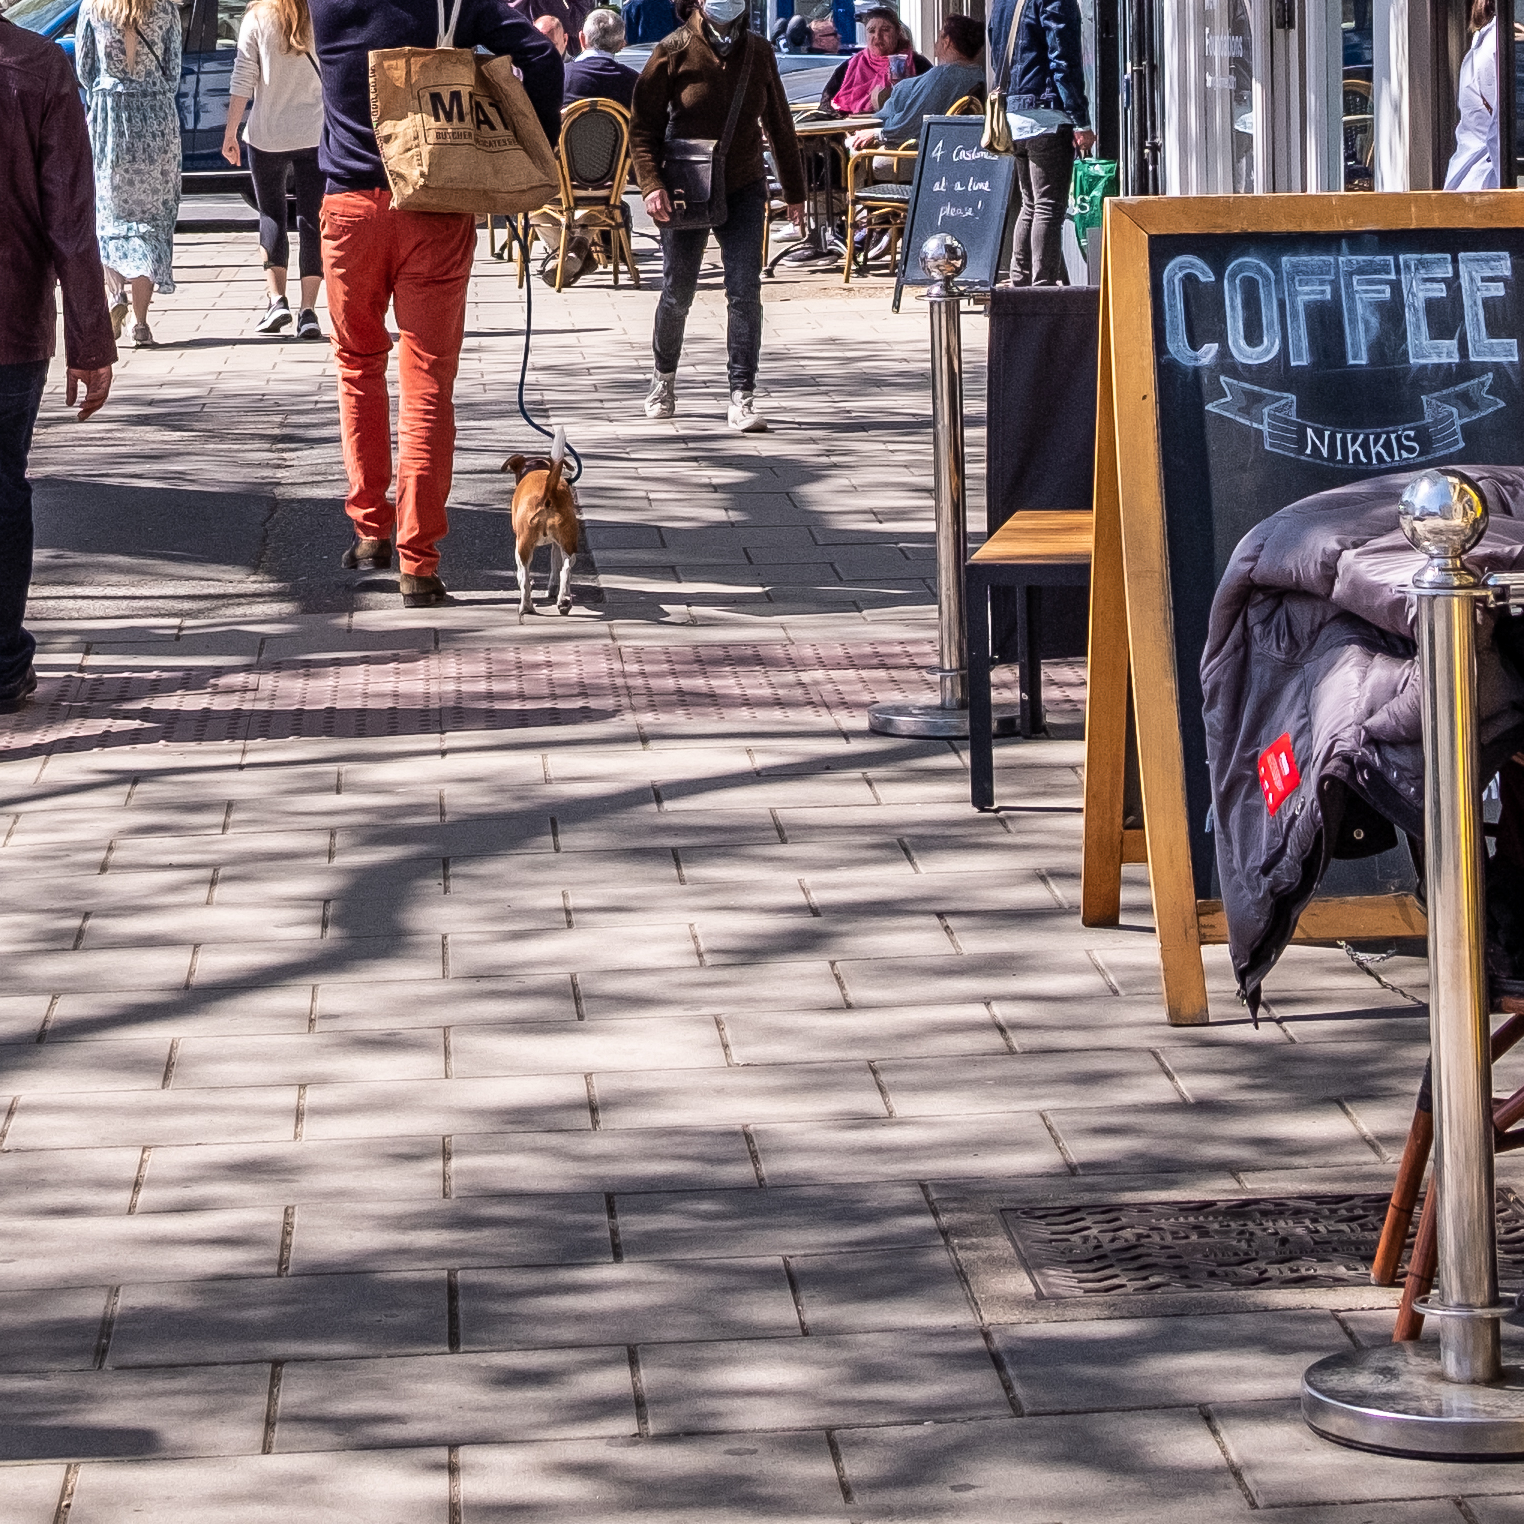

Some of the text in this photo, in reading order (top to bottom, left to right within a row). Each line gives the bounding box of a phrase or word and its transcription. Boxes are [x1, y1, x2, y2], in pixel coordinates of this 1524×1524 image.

[428, 89, 510, 133] MAT
[932, 139, 945, 163] 4
[932, 176, 947, 192] at
[954, 180, 966, 191] a
[1161, 251, 1519, 366] COFFEE
